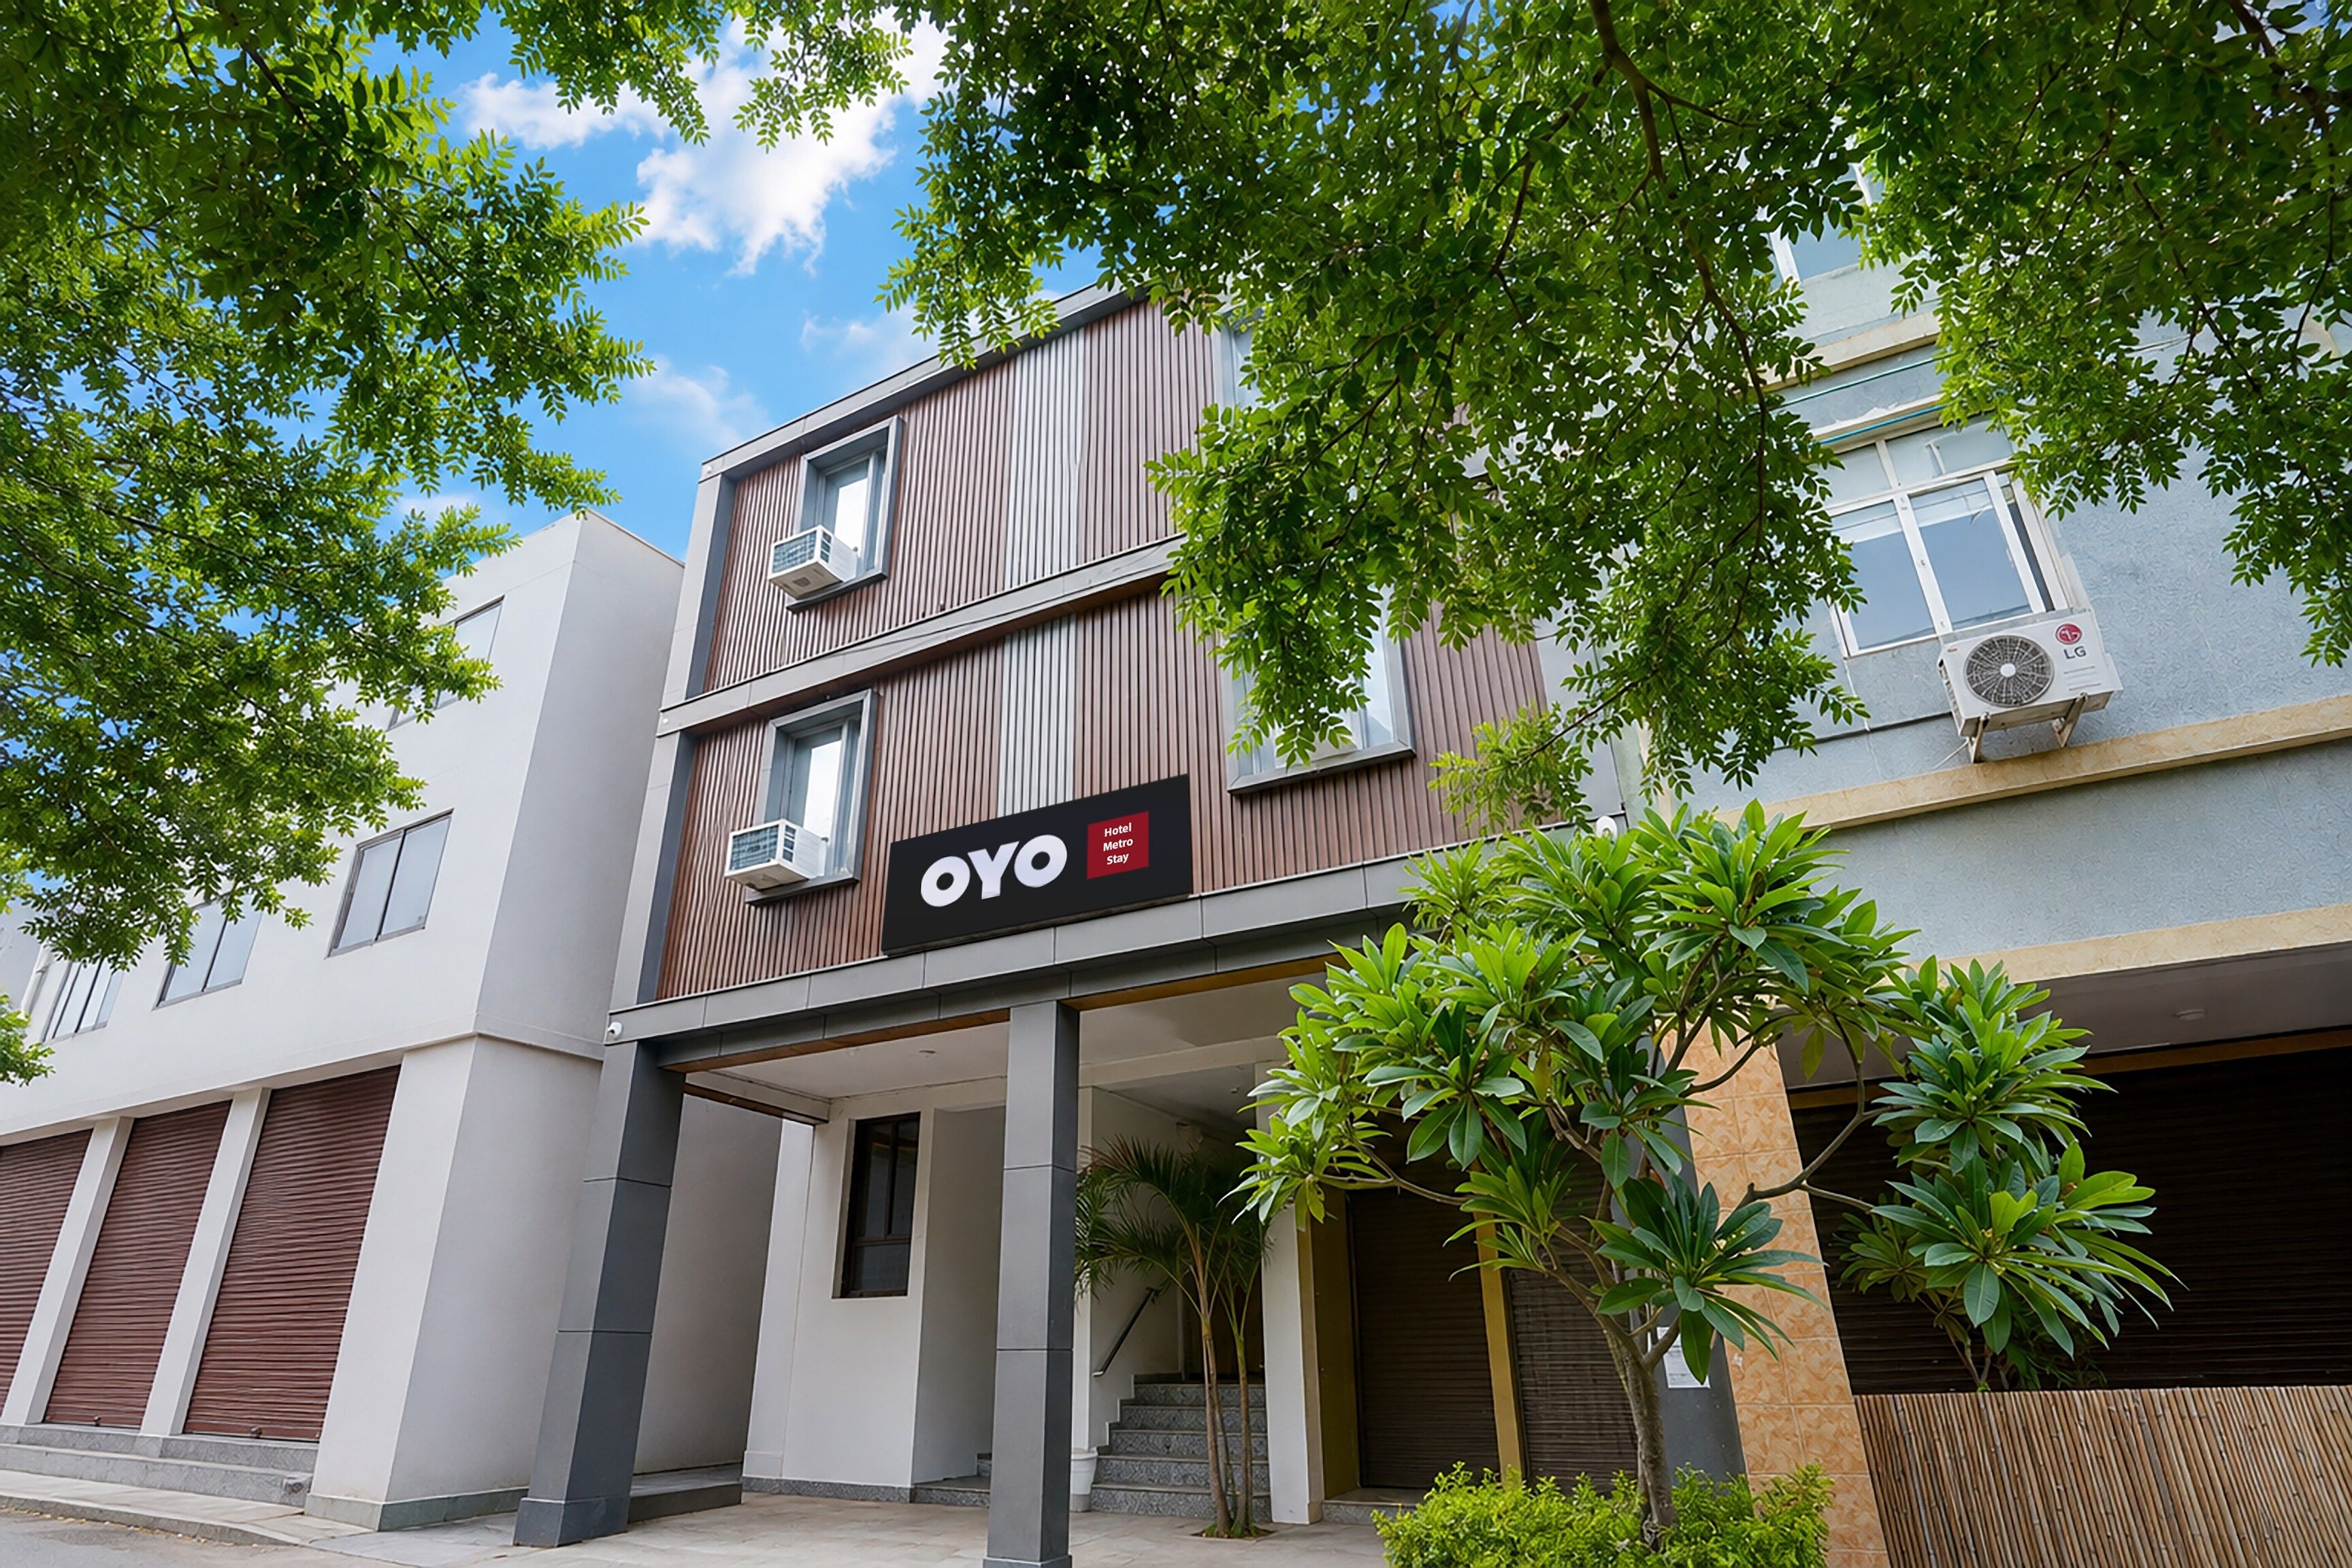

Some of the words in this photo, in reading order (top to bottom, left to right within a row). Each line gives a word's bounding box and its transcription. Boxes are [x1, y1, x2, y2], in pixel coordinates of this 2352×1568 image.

[2063, 646, 2087, 659] LG
[1104, 822, 1132, 837] Hotel
[1102, 838, 1134, 852] Metro
[1107, 852, 1130, 866] Stay
[921, 834, 1067, 907] OYO
